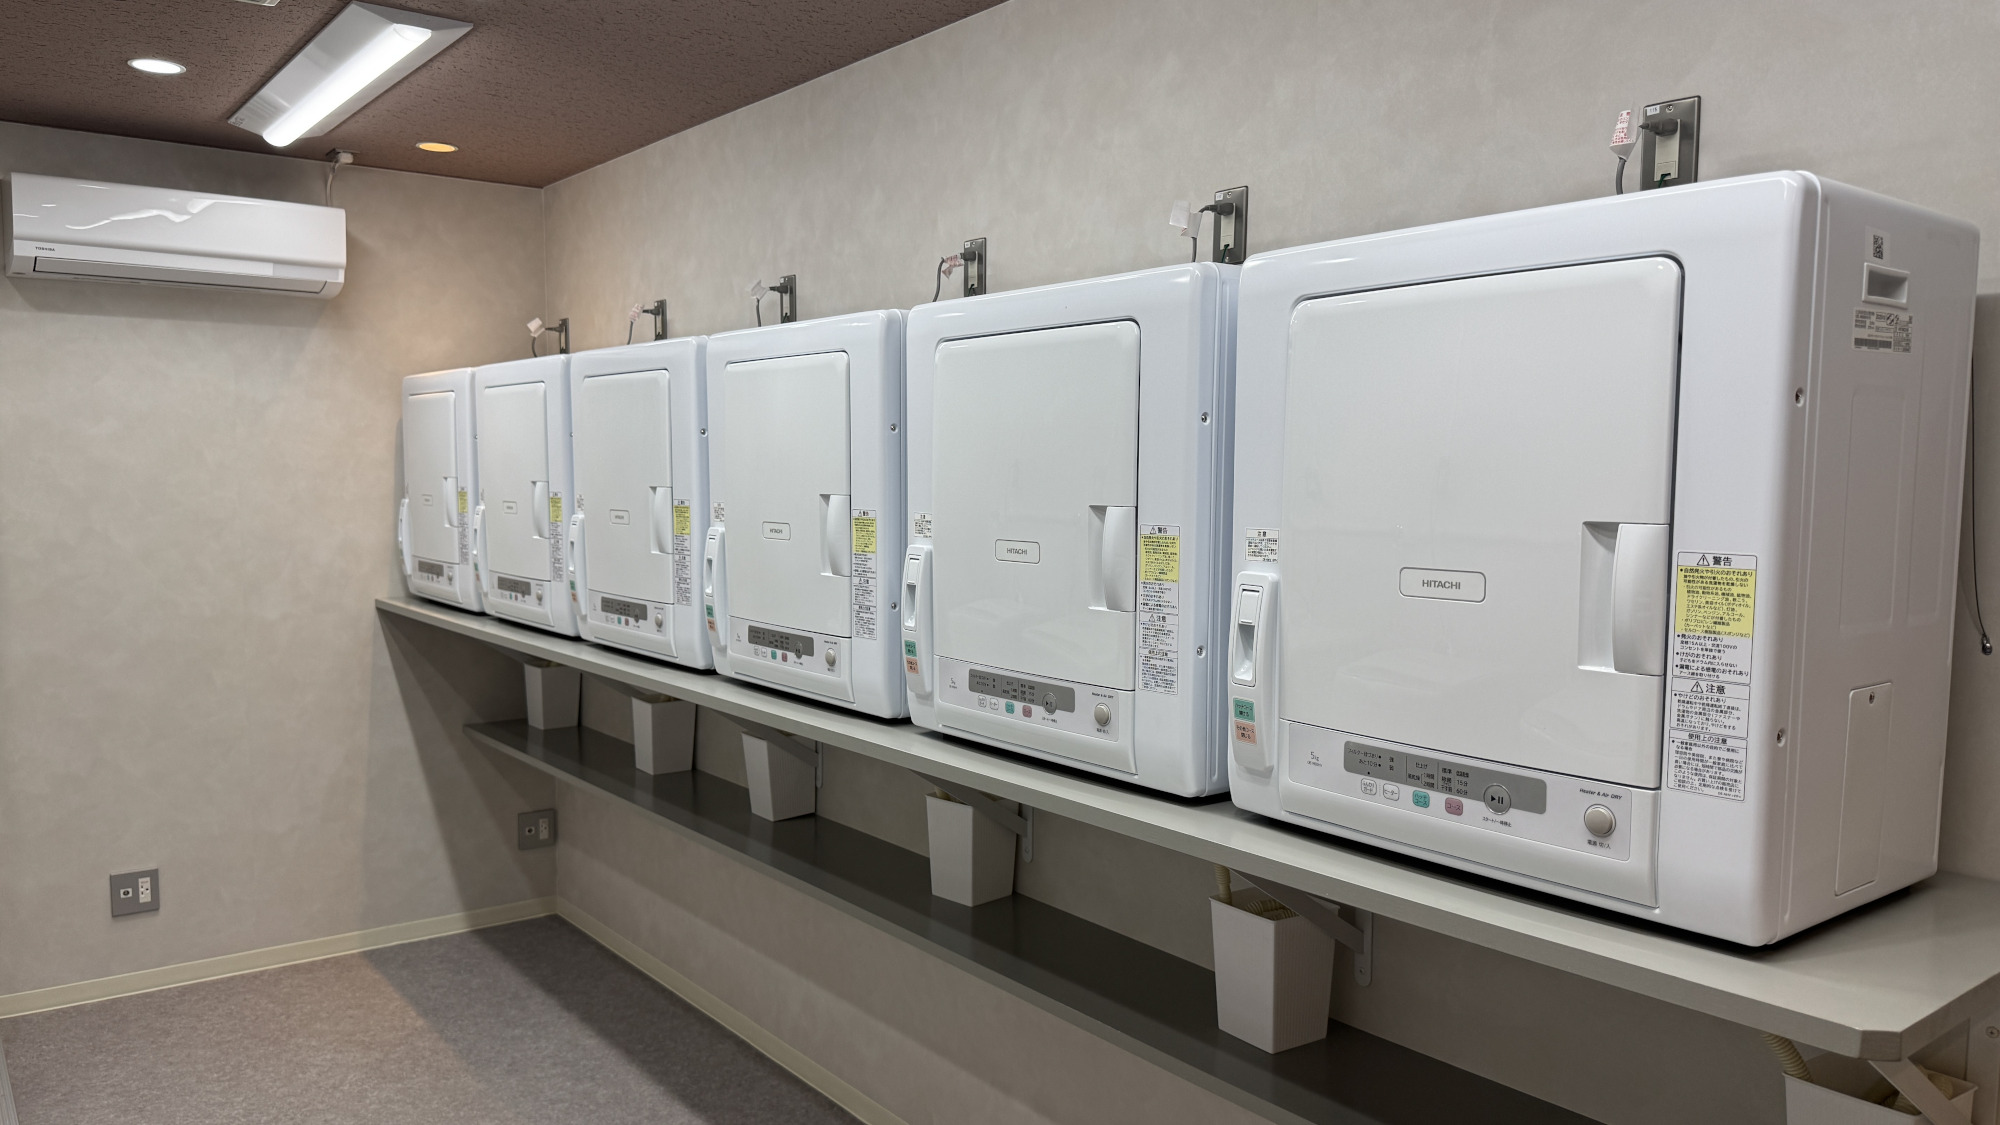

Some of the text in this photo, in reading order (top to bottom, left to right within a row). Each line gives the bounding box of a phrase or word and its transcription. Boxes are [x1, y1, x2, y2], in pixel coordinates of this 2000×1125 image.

[1712, 556, 1733, 566] 警告
[1683, 568, 1753, 577] 自然発火や引火のおそれあり
[1422, 580, 1461, 590] HITACHI
[1681, 634, 1723, 642] 発火のおそれあり
[1680, 652, 1722, 660] けがのおそれあり
[1679, 665, 1749, 676] 漏電による感電のおそれあり
[1705, 684, 1726, 695] 注意
[1678, 693, 1727, 703] やけどのおそれあり
[1688, 733, 1727, 745] 使用上の注意
[1359, 758, 1377, 767] あと10分
